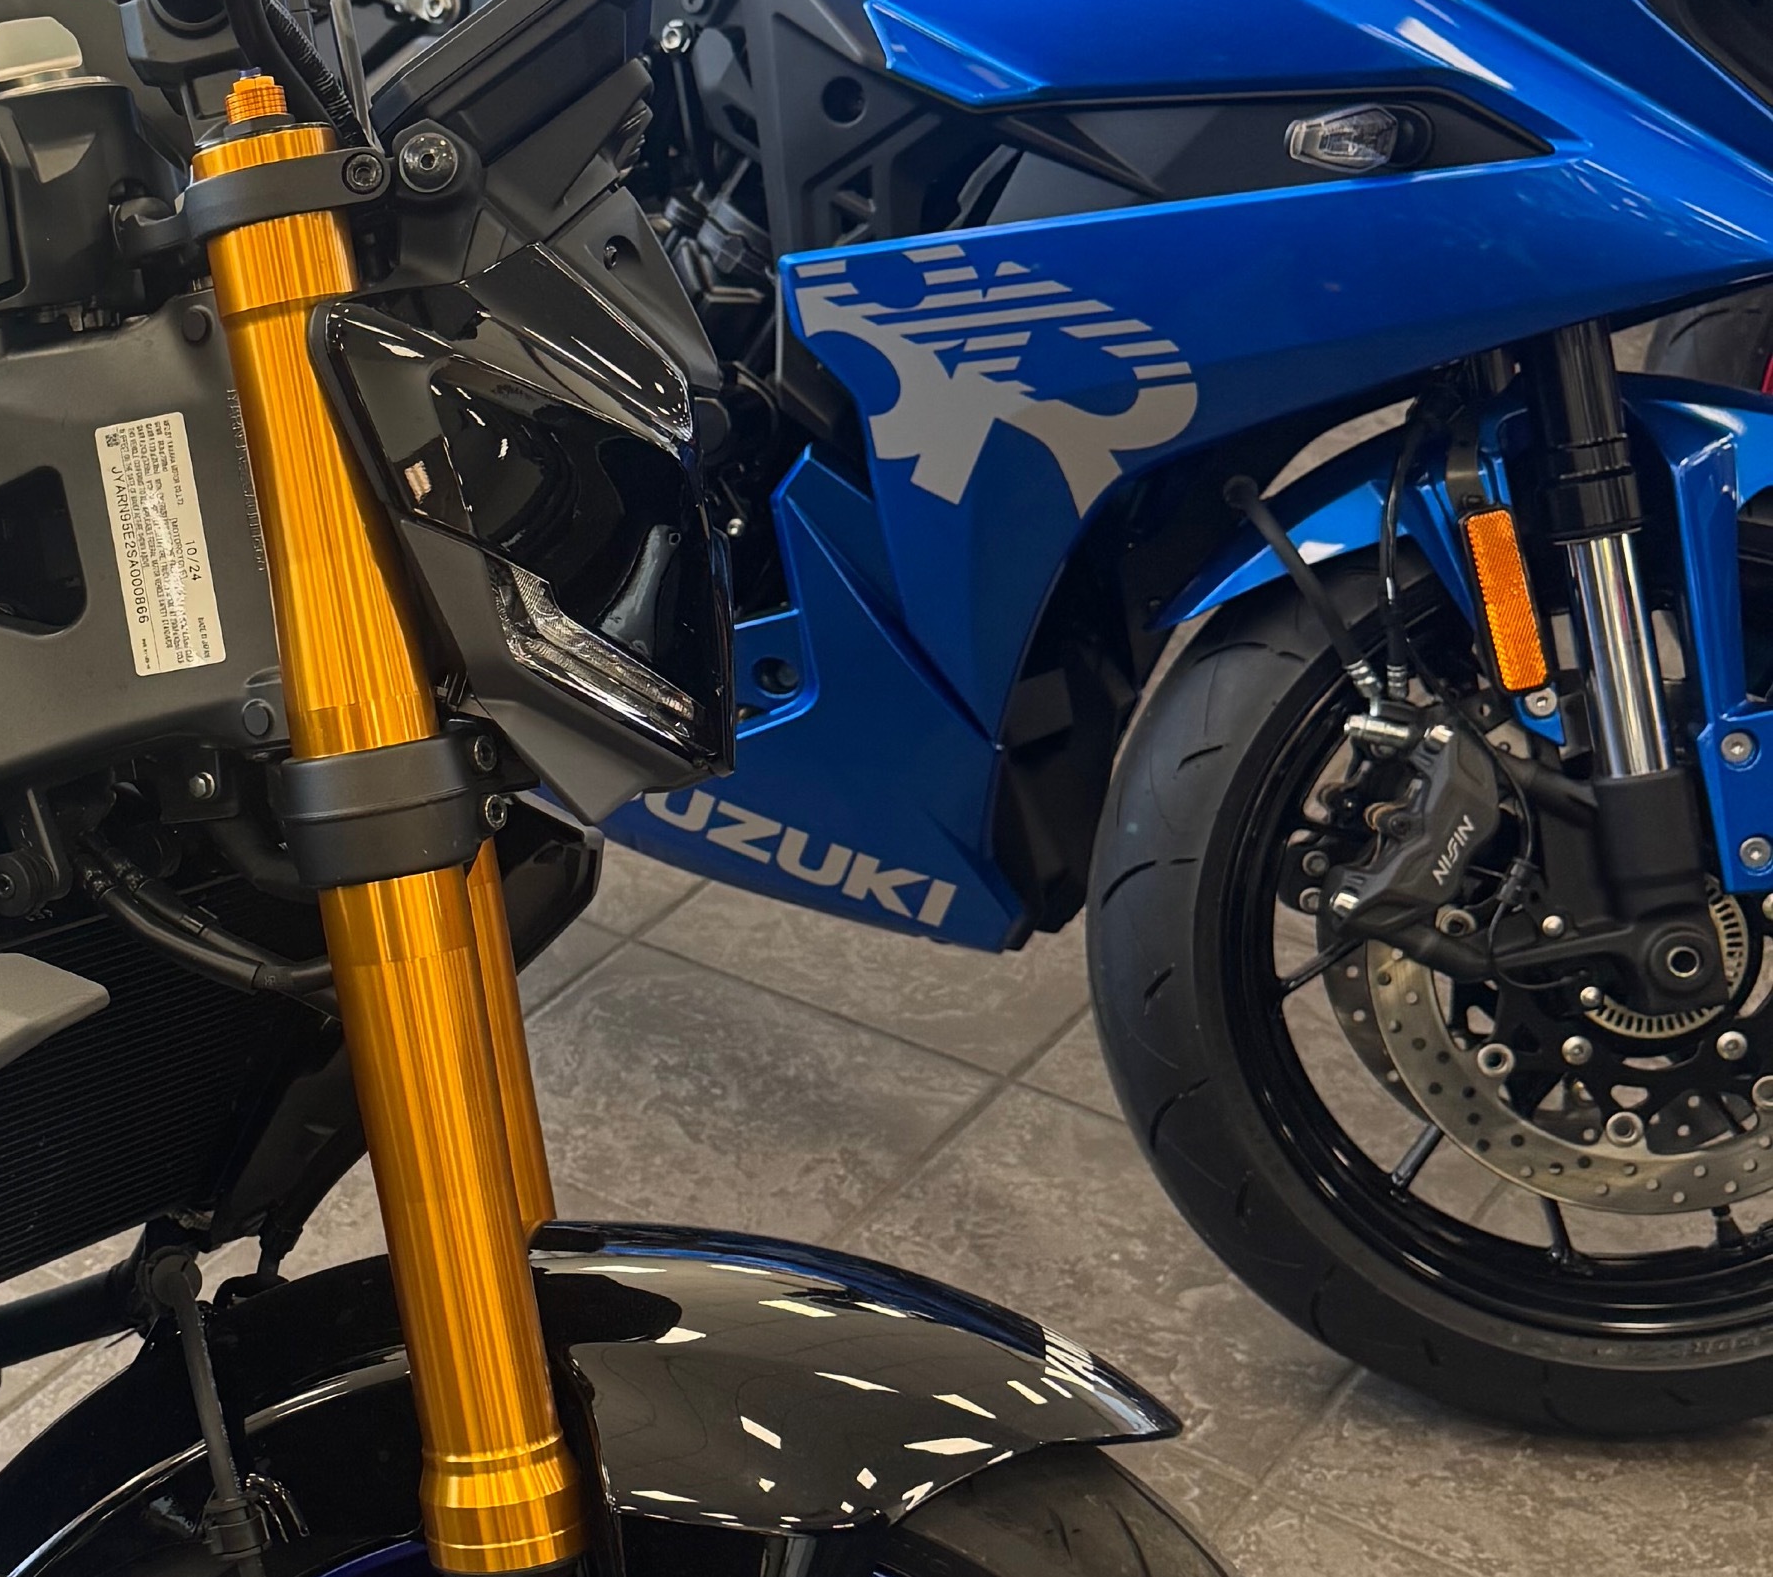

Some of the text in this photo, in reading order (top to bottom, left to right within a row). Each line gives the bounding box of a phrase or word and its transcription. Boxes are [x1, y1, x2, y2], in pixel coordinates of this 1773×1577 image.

[109, 464, 151, 624] JYARN95E2SA000866
[183, 539, 202, 582] 10/24
[627, 790, 958, 927] UZUKI
[1431, 814, 1477, 886] NISSIN
